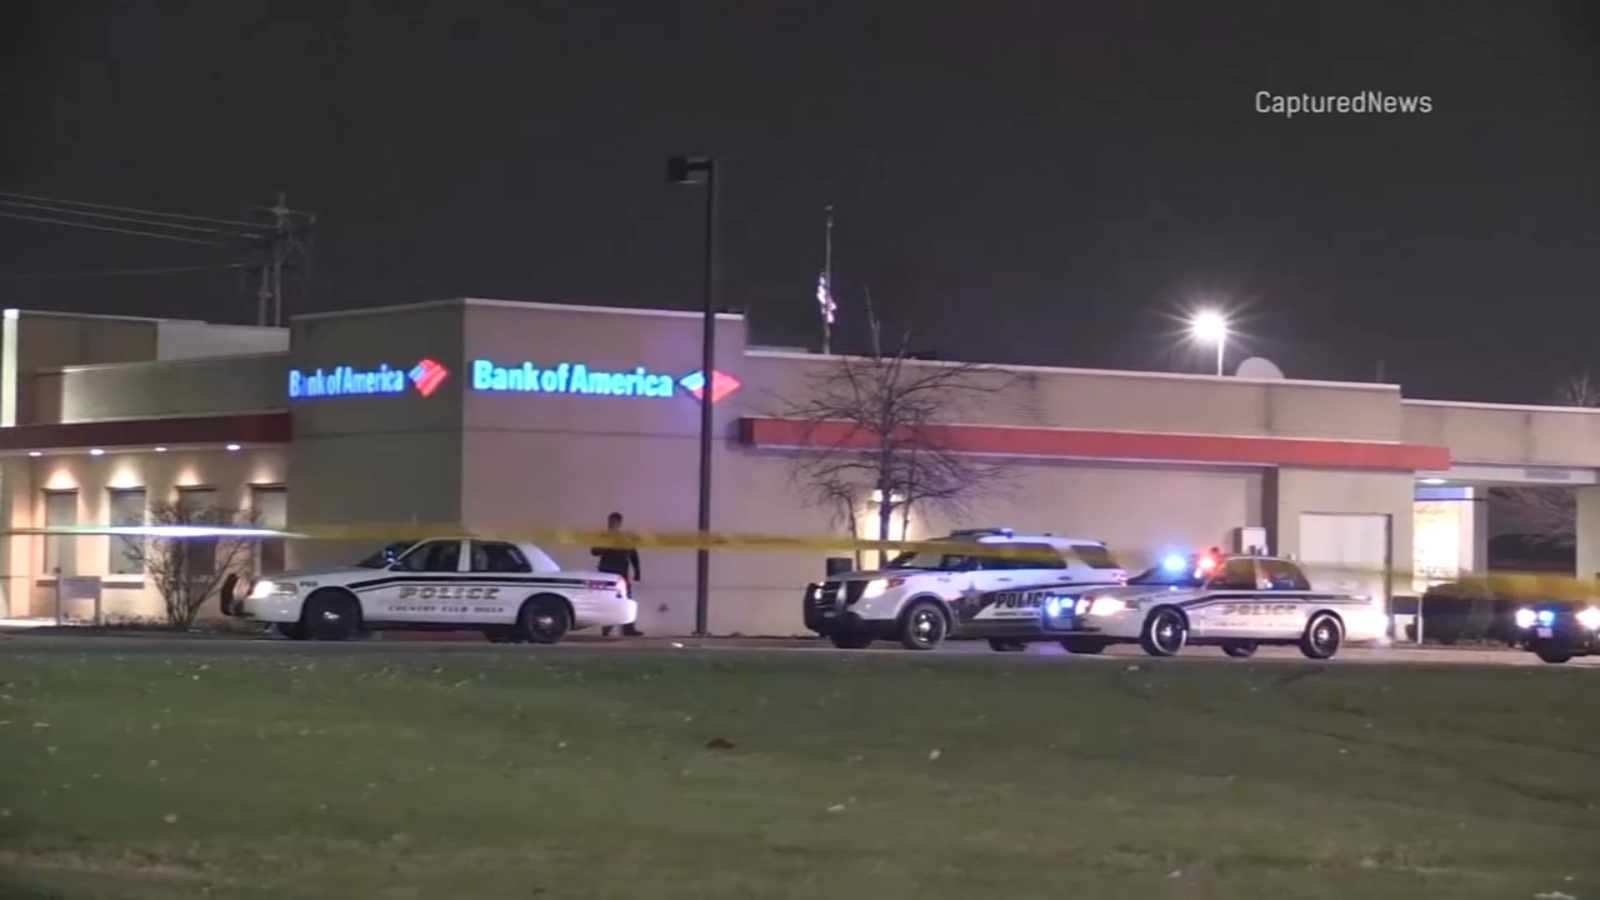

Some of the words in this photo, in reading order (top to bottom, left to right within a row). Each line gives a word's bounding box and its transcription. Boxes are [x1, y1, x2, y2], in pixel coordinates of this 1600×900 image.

[289, 368, 326, 397] Bank
[326, 366, 343, 395] of
[343, 364, 404, 394] America
[474, 359, 540, 391] Bank
[540, 362, 570, 392] of
[569, 364, 674, 397] America
[399, 587, 501, 600] POLICE
[1222, 604, 1297, 616] POLICE
